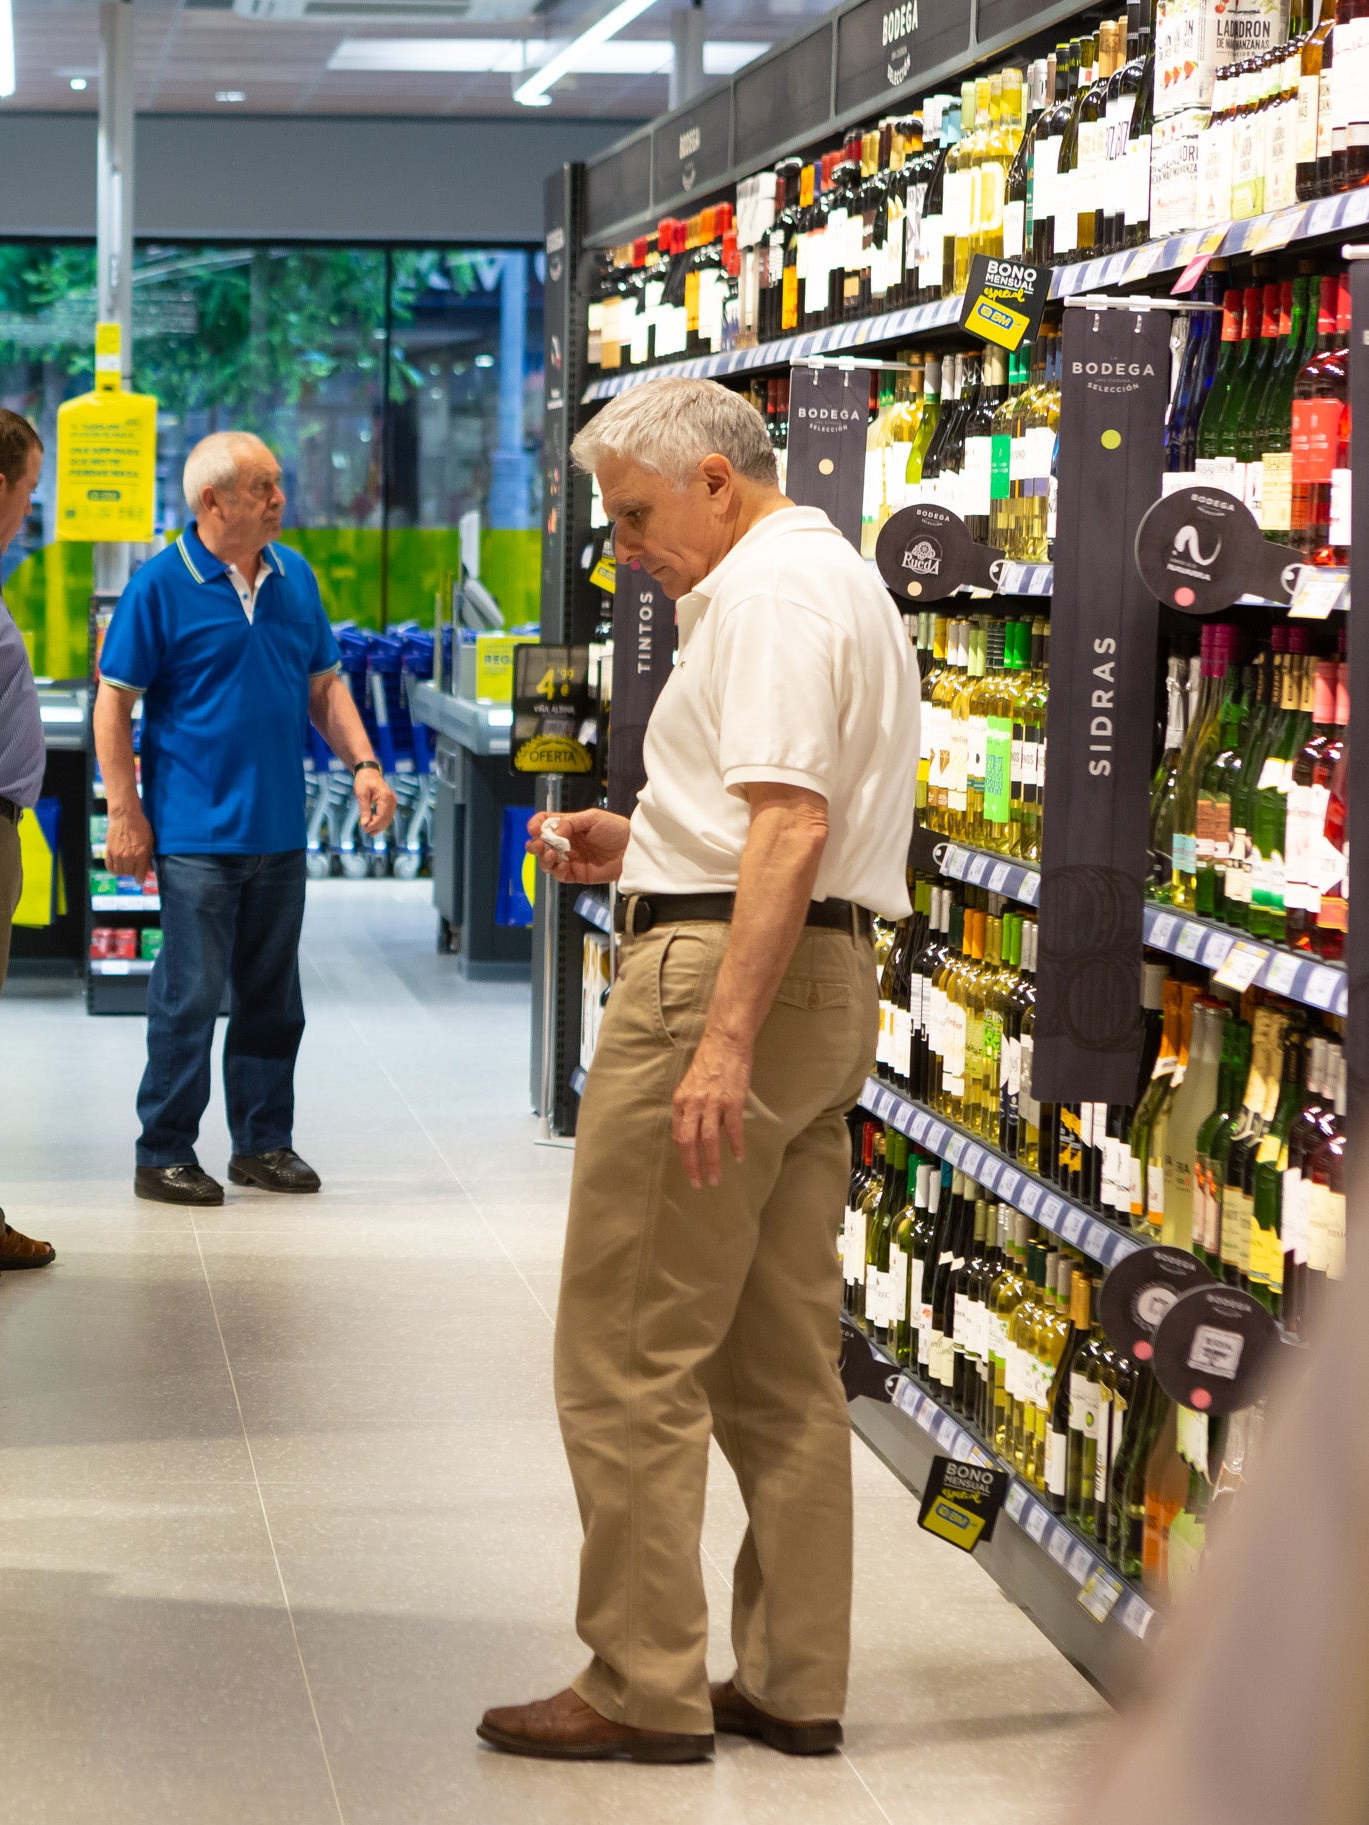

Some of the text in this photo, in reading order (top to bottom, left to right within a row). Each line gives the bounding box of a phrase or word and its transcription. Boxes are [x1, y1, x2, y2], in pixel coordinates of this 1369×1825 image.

[882, 0, 918, 47] BODEGA
[987, 260, 1037, 282] BONO
[985, 273, 1035, 291] MENSUAL
[1071, 361, 1156, 377] BODEGA
[1086, 382, 1140, 393] SELECCIÓN
[798, 407, 860, 421] BODEGA
[809, 423, 849, 433] SELECCIÓN
[916, 509, 950, 522] BODEGA
[637, 590, 654, 674] TINTOS
[1088, 637, 1117, 777] SIDRAS
[529, 750, 576, 763] OFERTA
[945, 1462, 994, 1485] BONO
[943, 1475, 991, 1494] MENSUAL
